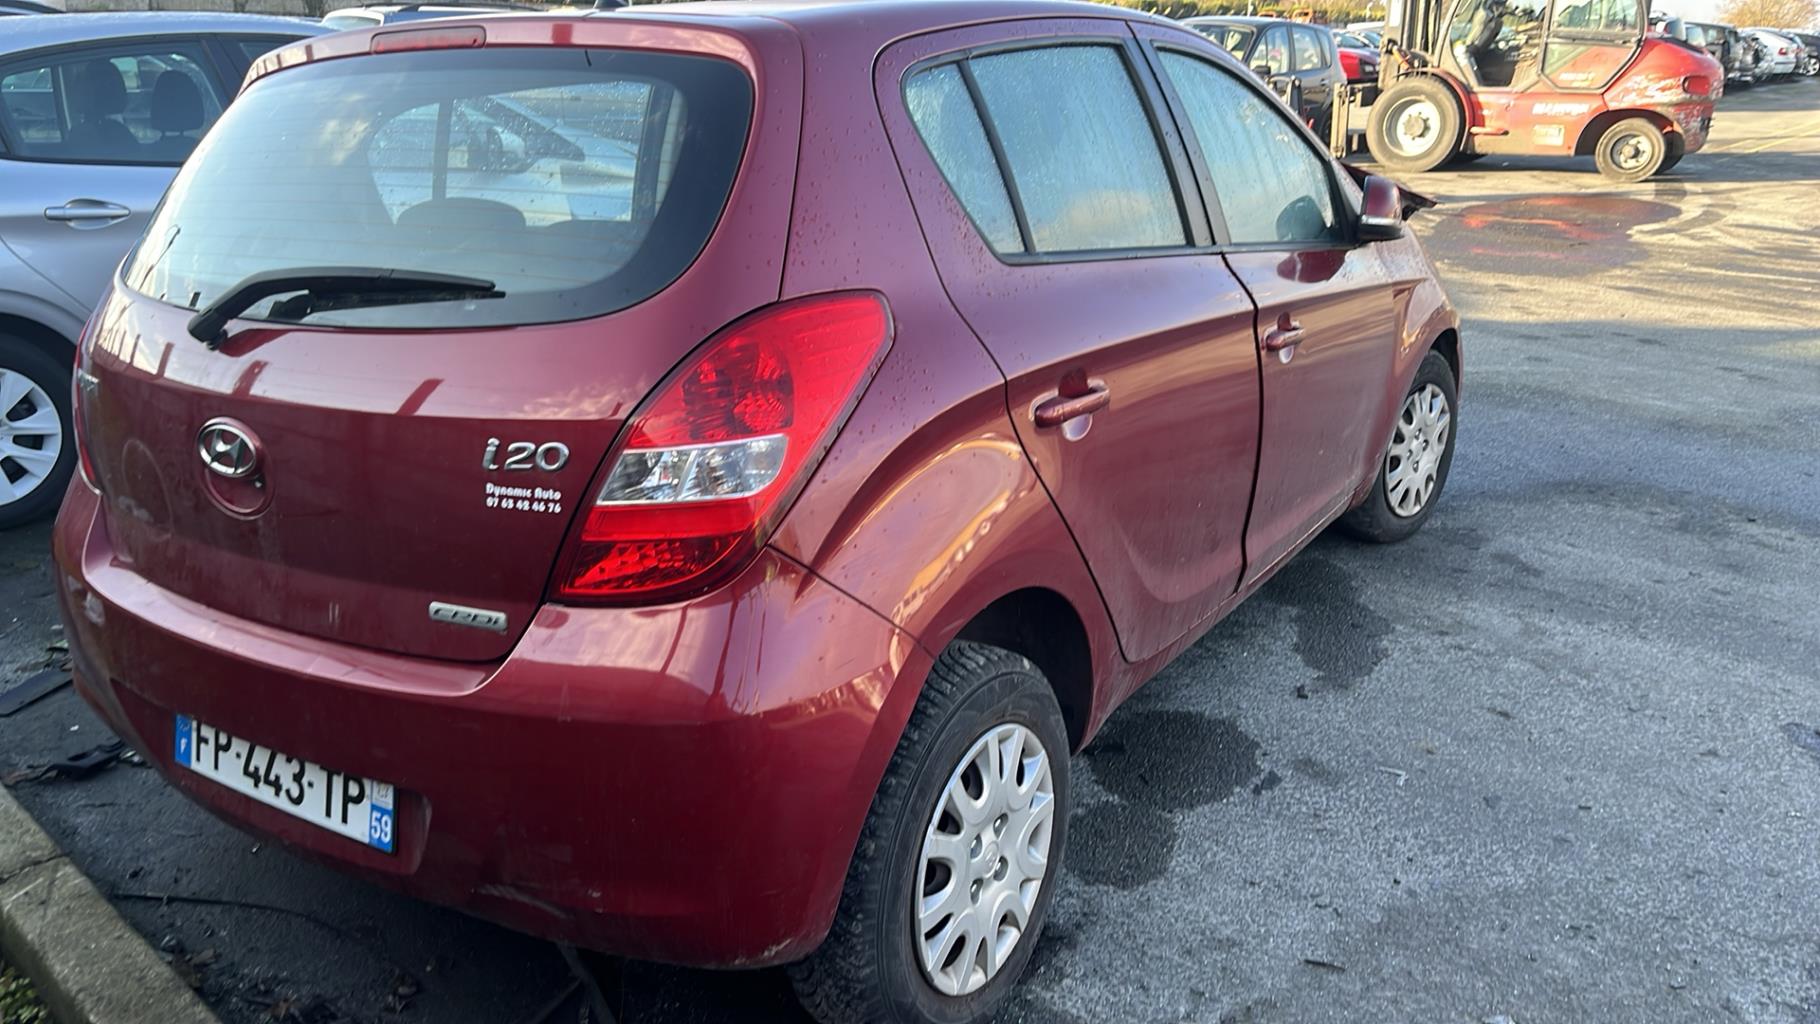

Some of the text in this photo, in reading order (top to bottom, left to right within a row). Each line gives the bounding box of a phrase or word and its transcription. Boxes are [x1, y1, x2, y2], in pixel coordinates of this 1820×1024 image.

[482, 437, 570, 470] i20
[485, 482, 562, 501] Dynamic Auto
[486, 497, 499, 508] 07
[516, 500, 530, 511] 42
[547, 502, 562, 514] 76
[371, 810, 392, 844] 59
